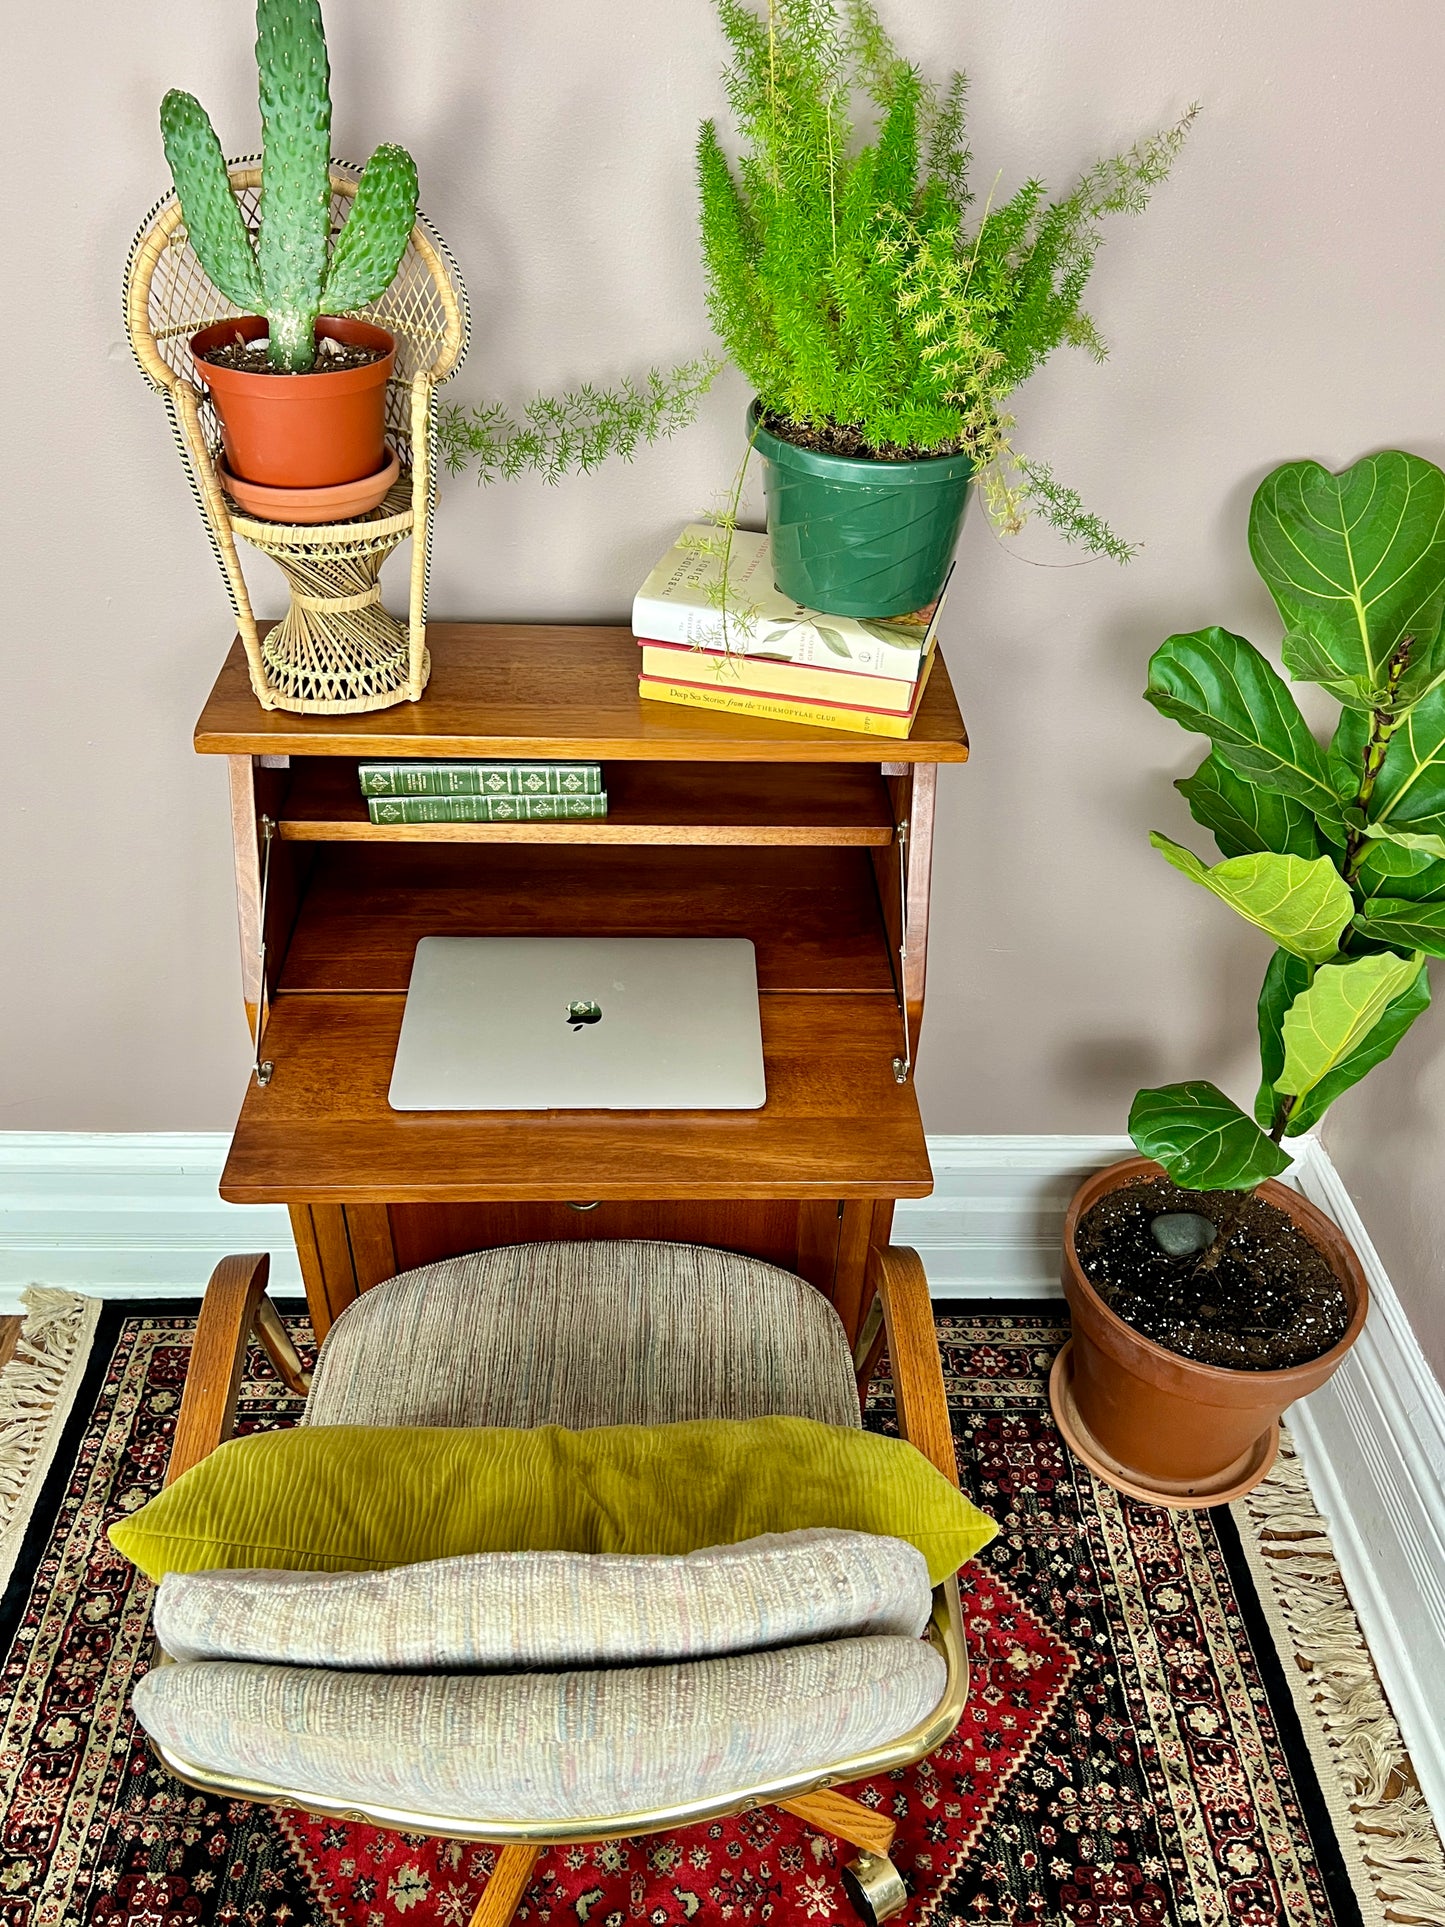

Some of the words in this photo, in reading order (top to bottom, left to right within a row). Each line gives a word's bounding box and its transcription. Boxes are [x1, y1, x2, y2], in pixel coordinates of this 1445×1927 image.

[661, 587, 673, 597] The
[668, 557, 696, 587] BEDSIDE
[687, 560, 711, 581] BIRDS
[741, 559, 760, 583] GRAEME
[669, 688, 689, 700] Deep
[689, 692, 701, 701] Sea
[702, 694, 726, 705] Stories
[726, 698, 743, 707] from
[744, 701, 756, 709] the
[757, 704, 813, 719] THERMOPYLAE
[815, 713, 836, 722] CLUB
